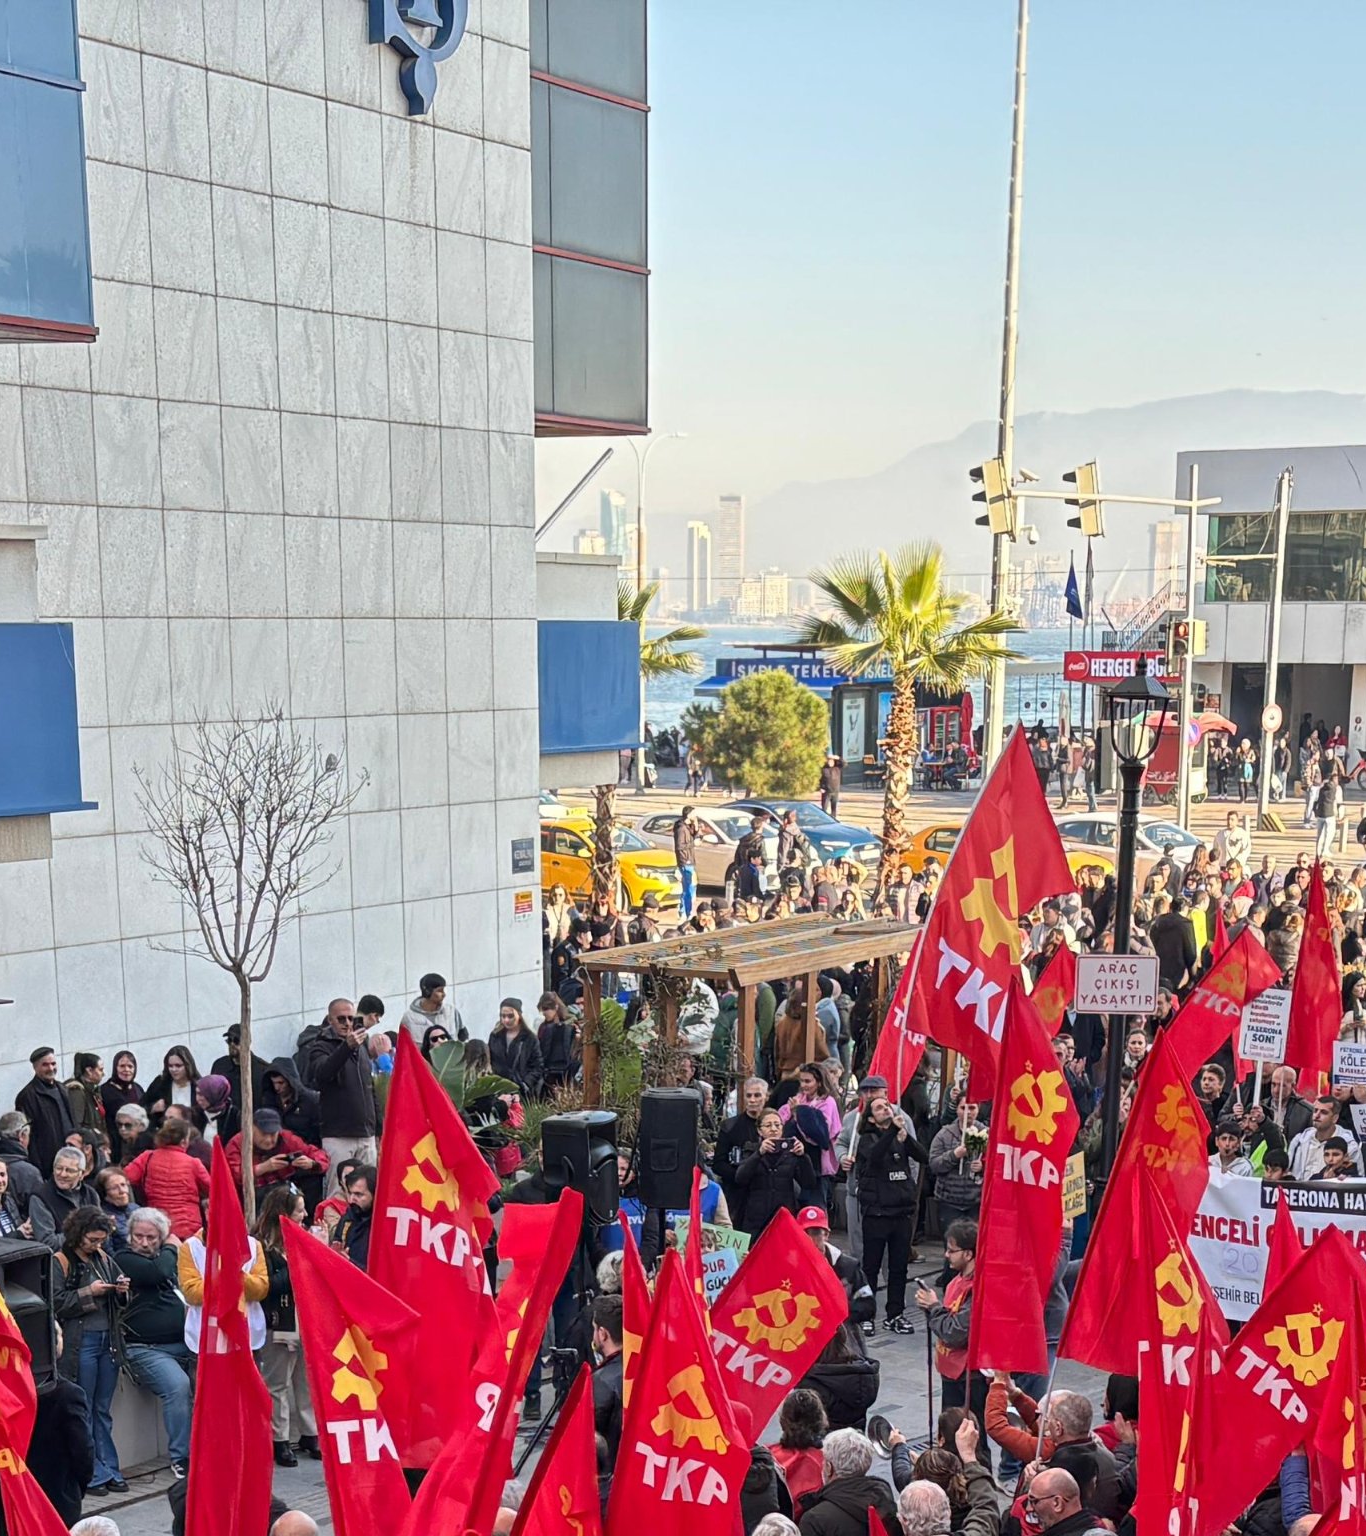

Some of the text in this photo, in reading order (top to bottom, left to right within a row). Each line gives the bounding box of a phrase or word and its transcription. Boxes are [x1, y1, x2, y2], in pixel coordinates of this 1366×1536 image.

[864, 664, 895, 680] İSKEL
[1091, 658, 1136, 677] HERGEL
[1094, 979, 1140, 991] ÇIKIŞI
[1097, 963, 1138, 975] ARAÇ
[1081, 994, 1153, 1006] YASAKTIR
[997, 1143, 1060, 1190] TKP
[385, 1206, 472, 1267] TKP
[1191, 1213, 1260, 1247] ENCELİ
[710, 1330, 792, 1390] TKP
[1235, 1345, 1308, 1424] TKP
[327, 1418, 398, 1465] TK
[635, 1441, 730, 1506] TKP
